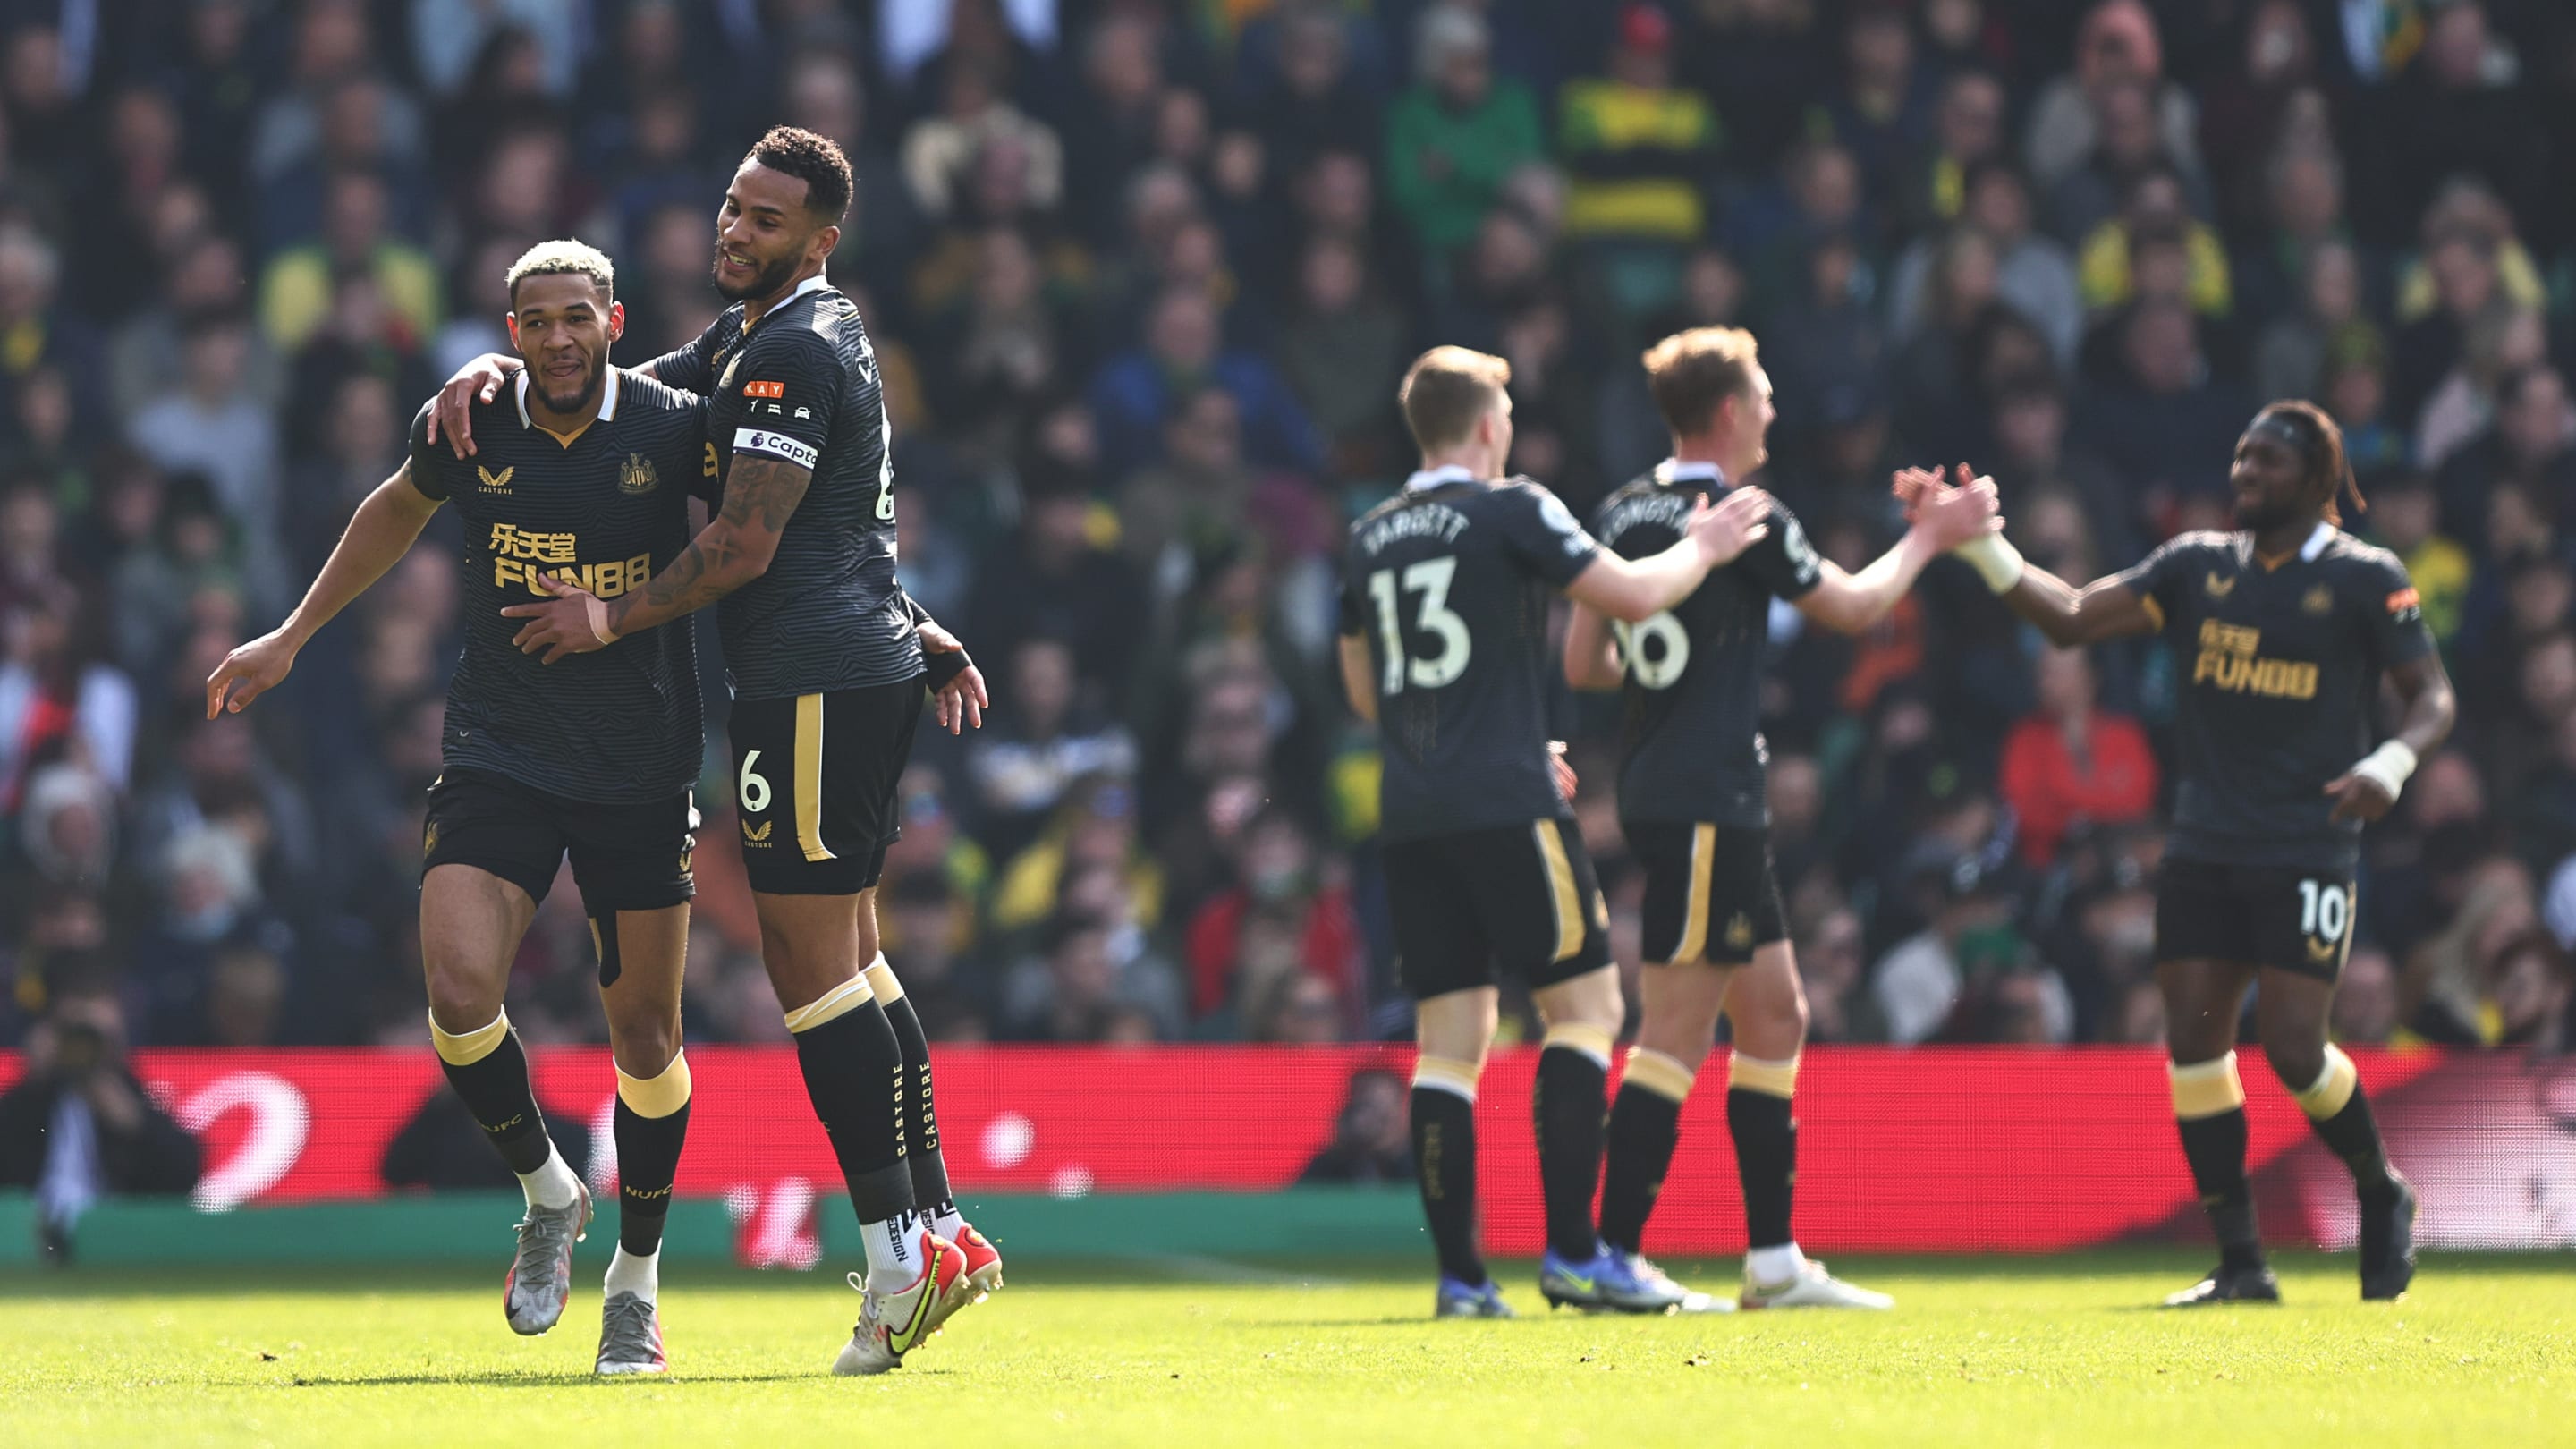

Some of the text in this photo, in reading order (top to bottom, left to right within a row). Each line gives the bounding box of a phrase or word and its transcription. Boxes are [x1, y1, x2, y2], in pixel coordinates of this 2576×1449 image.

[478, 486, 513, 495] CASTORE
[488, 522, 577, 564] 乐天堂
[494, 552, 651, 598] FUN88
[1368, 555, 1471, 696] 13
[740, 750, 772, 812] 6
[2298, 878, 2347, 942] 10
[894, 1063, 907, 1157] CASTORE
[919, 1061, 937, 1150] CASTORE
[625, 1182, 673, 1199] NUFC
